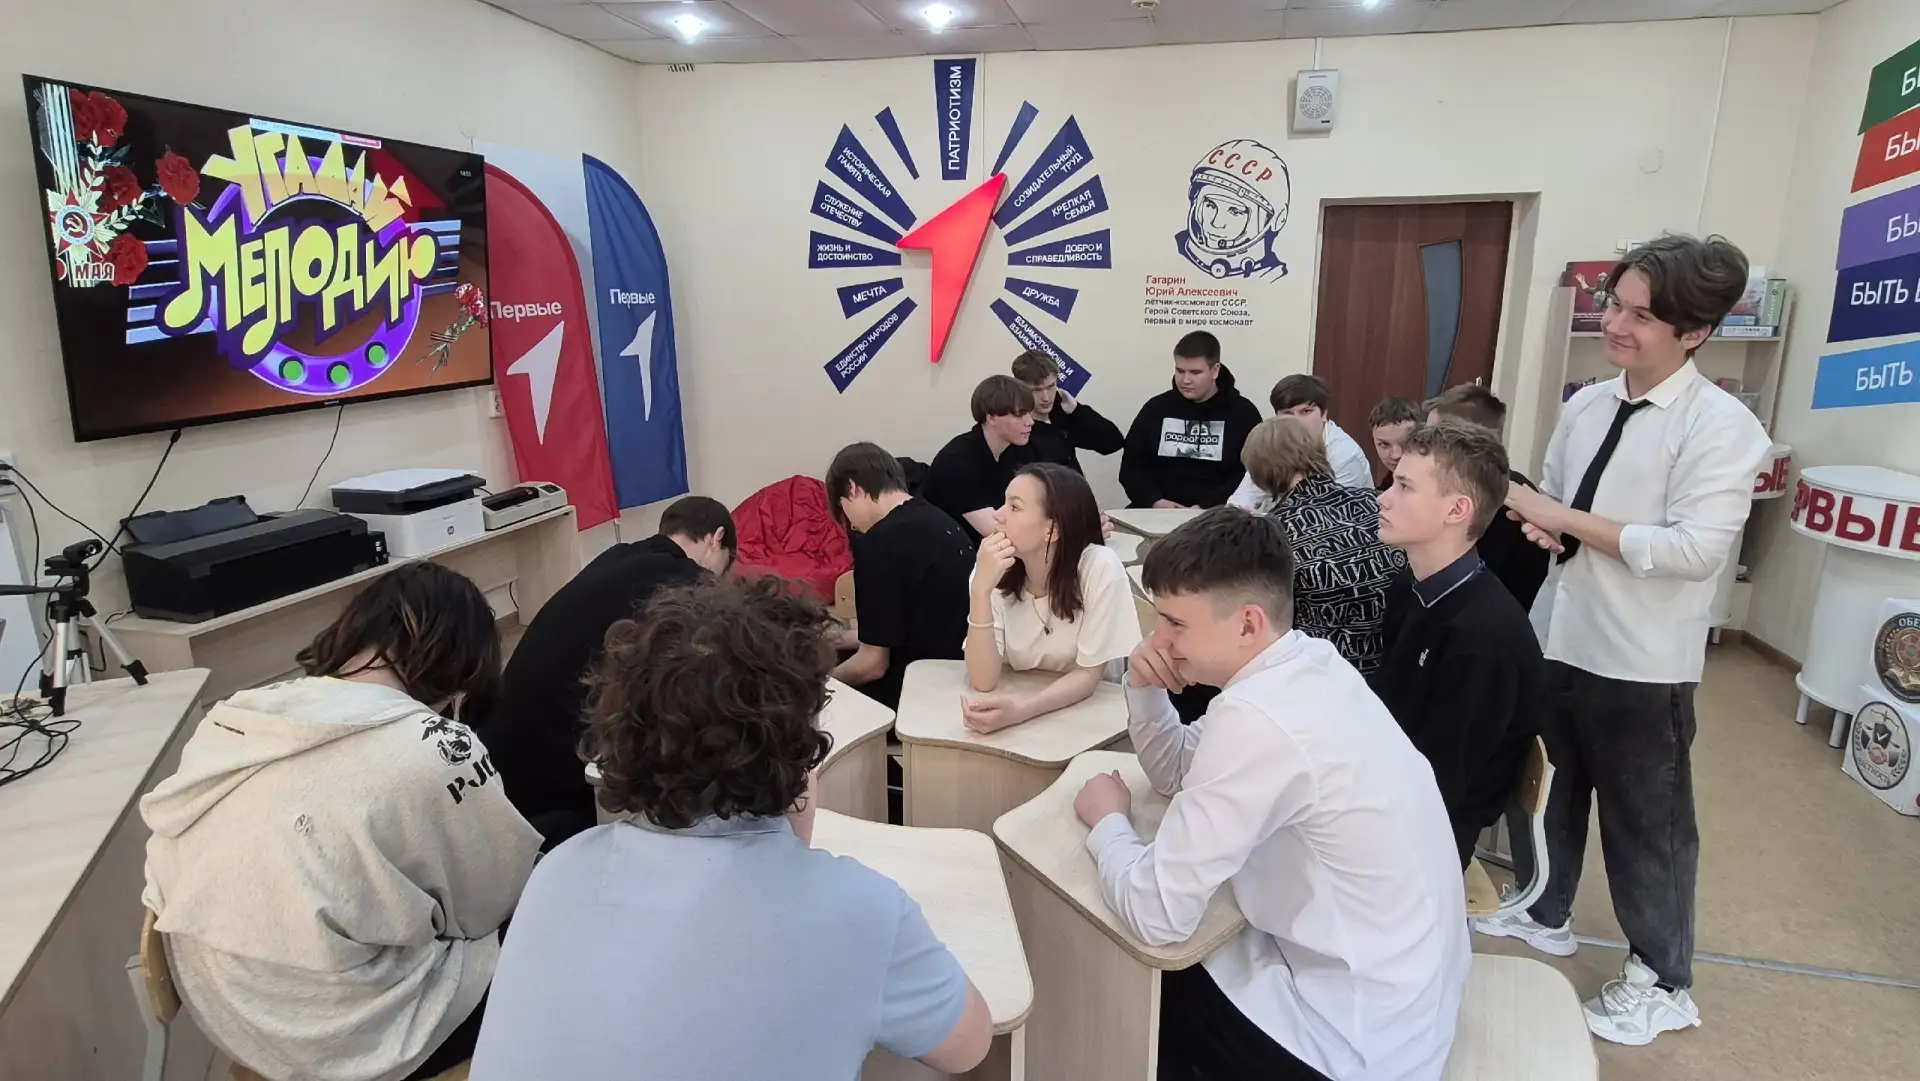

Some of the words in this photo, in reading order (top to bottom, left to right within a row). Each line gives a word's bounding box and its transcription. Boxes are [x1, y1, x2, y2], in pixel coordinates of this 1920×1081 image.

[948, 65, 962, 170] ПАТРИОТИЗМ
[837, 153, 863, 183] ПАМЯТЬ
[842, 146, 892, 198] ИСТОРИЧЕСКАЯ
[1060, 152, 1084, 173] ТРУД
[1208, 149, 1273, 182] СССР
[202, 122, 413, 234] УГАДАЙ
[1013, 144, 1077, 208] СОЗИДАТЕЛЬНЫЙ
[820, 202, 863, 228] ОТЕЧЕСТВУ
[824, 194, 864, 219] СЛУЖЕНИЕ
[1051, 189, 1092, 217] КРЕПКАЯ
[1064, 200, 1096, 221] СЕМЬЯ
[817, 243, 844, 252] ЖИЗНЬ
[817, 252, 874, 262] ДОСТОИНСТВО
[1025, 252, 1103, 263] СПРАВЕДЛИВОСТЬ
[1064, 243, 1095, 254] ДОБРО
[1096, 243, 1103, 251] И
[74, 262, 115, 281] МАЯ
[164, 207, 437, 356] МЕЛОДИЮ
[1145, 275, 1186, 286] Гагарин
[610, 288, 656, 309] Первые
[852, 285, 888, 304] МЕЧТА
[1022, 285, 1060, 308] ДРУЖБА
[1145, 286, 1175, 297] Юрий
[1177, 287, 1238, 297] Алексеевич
[1850, 278, 1909, 306] БЫТЬ
[490, 301, 562, 322] Первые
[1144, 307, 1169, 316] Герой
[1171, 308, 1218, 316] Советского
[1220, 308, 1250, 317] Союза,
[1144, 317, 1176, 325] первый
[1185, 318, 1208, 326] мире
[1209, 318, 1254, 326] космонавт
[835, 340, 869, 372] ЕДИНСТВО
[867, 313, 899, 343] НАРОДОВ
[1015, 315, 1066, 370] ВЗАИМОПОМОЩЬ
[1065, 368, 1074, 376] И
[840, 352, 869, 379] РОССИИ
[1855, 360, 1913, 391] БЫТЬ
